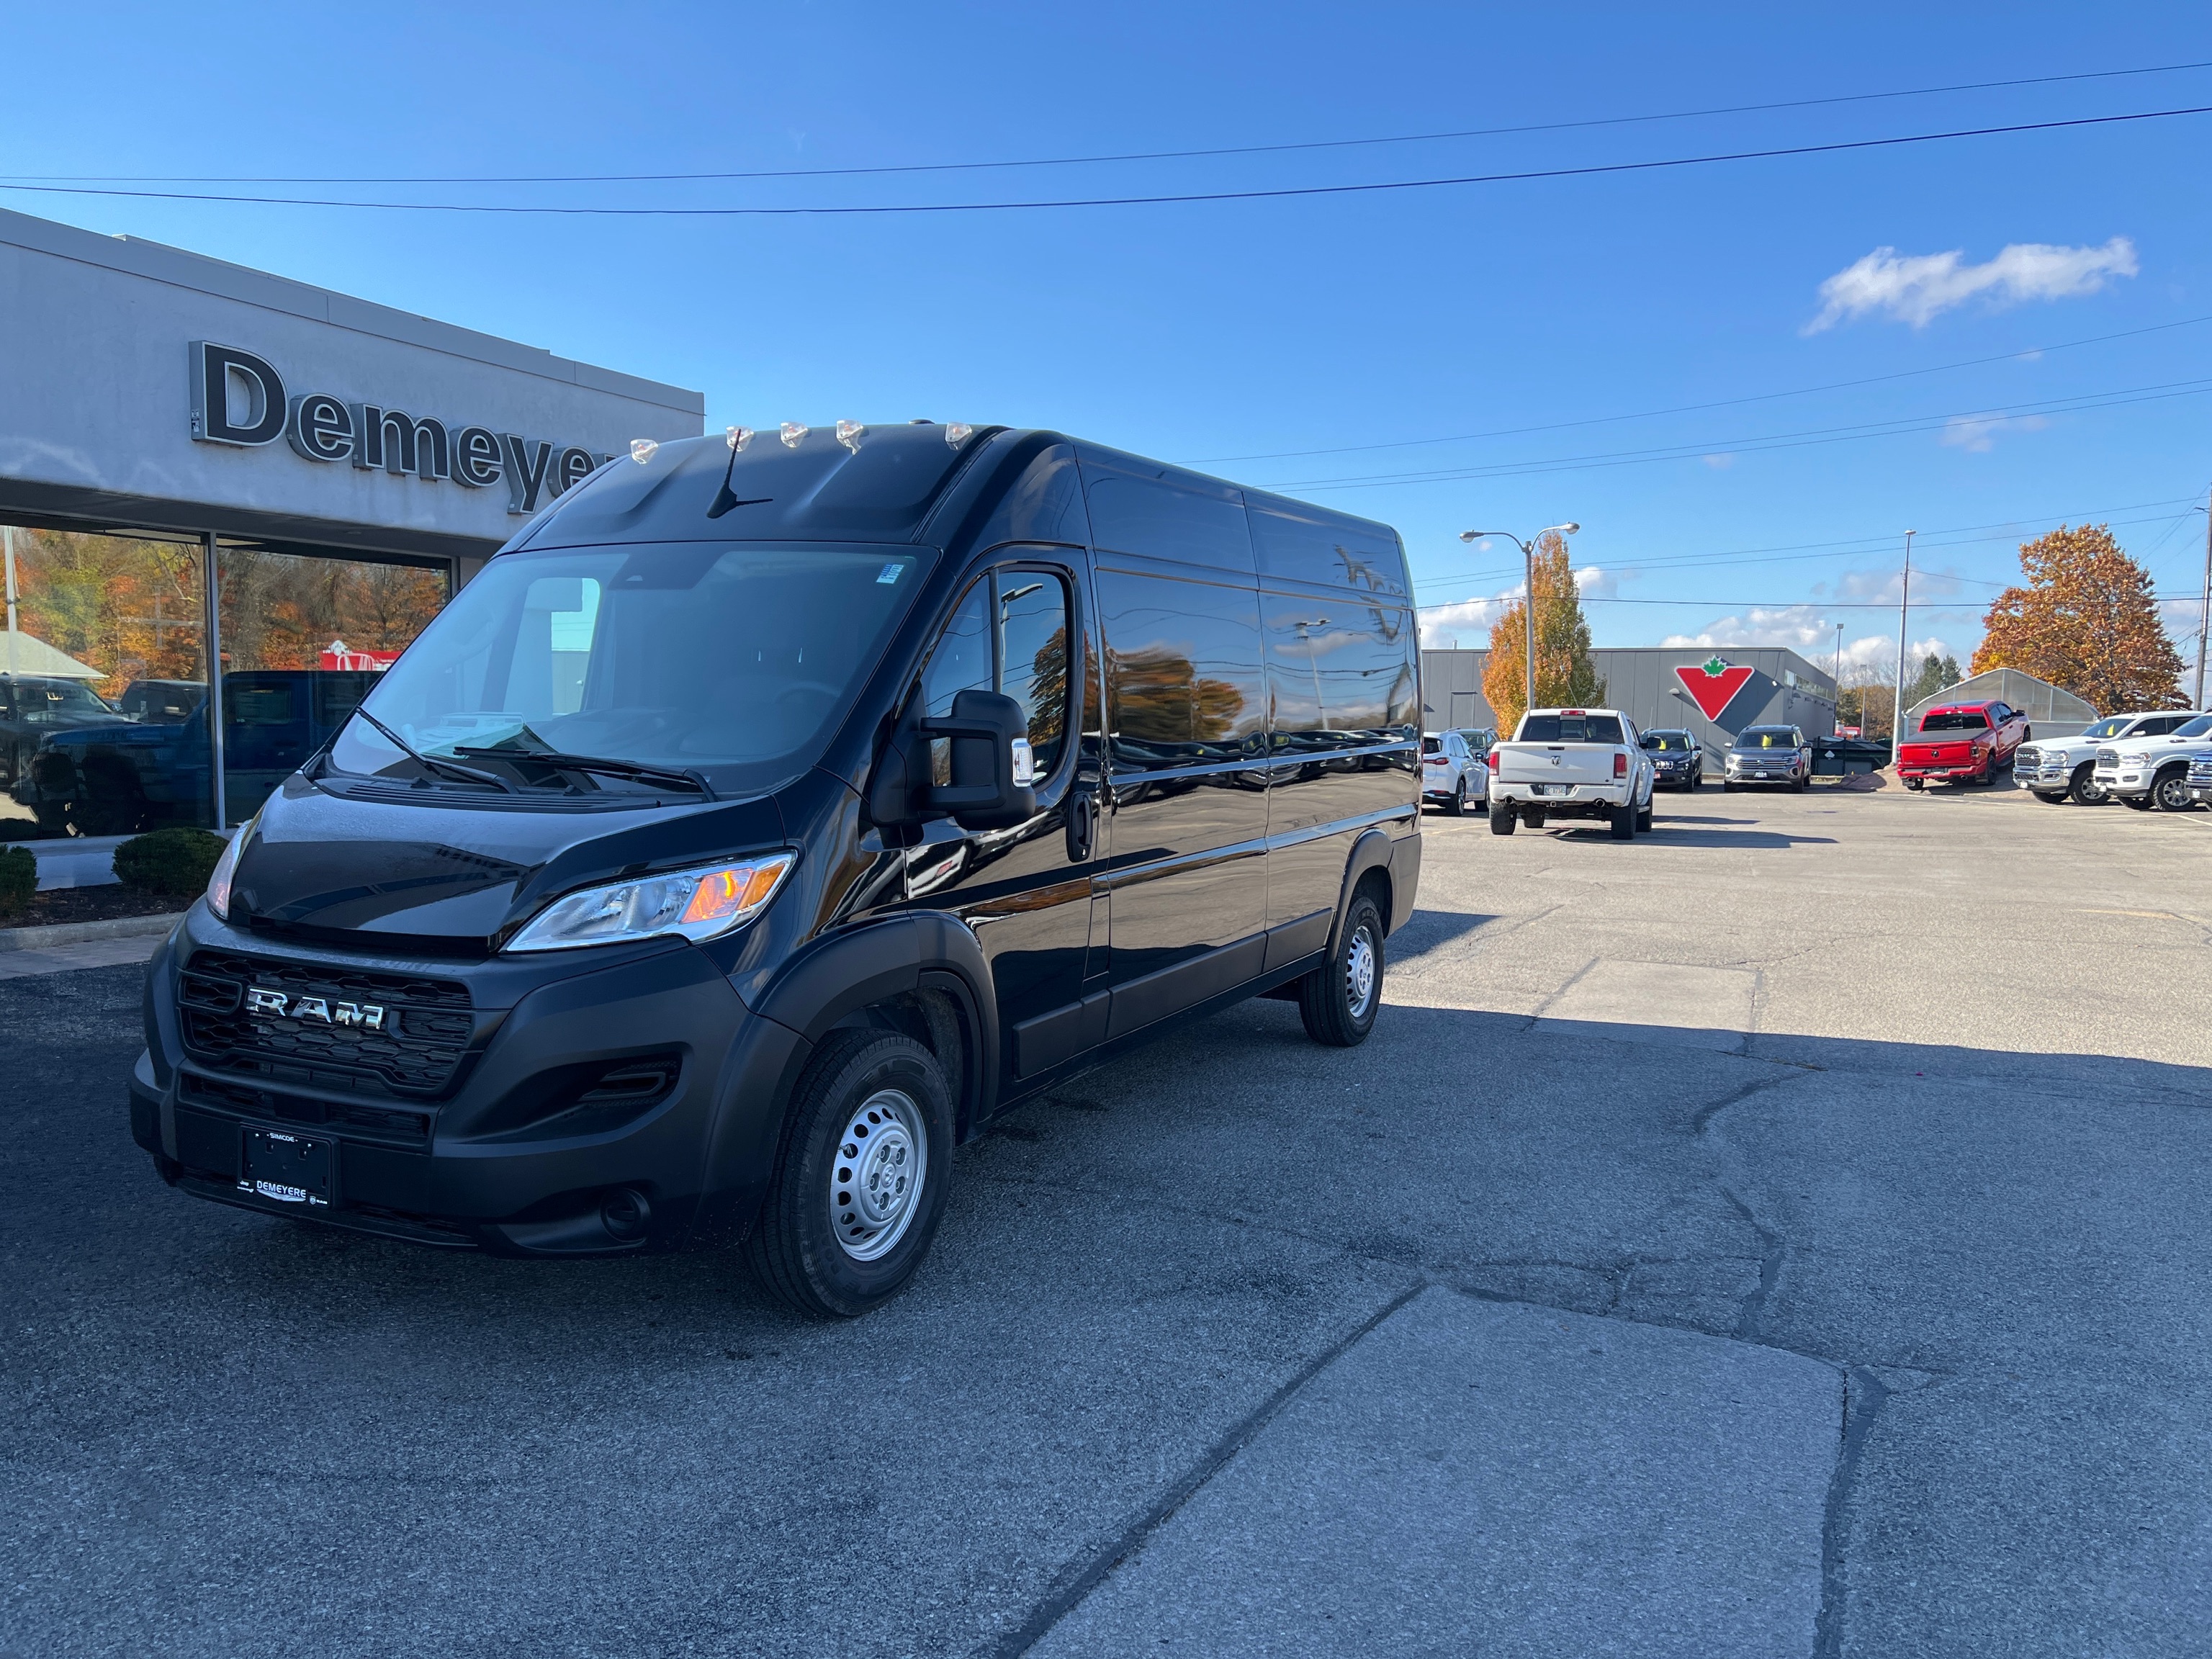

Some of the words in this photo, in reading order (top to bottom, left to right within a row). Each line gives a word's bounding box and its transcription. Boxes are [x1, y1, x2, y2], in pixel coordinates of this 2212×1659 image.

[189, 339, 619, 515] Demeye
[246, 988, 384, 1030] RAM
[269, 1132, 295, 1143] SIMCOE
[256, 1179, 307, 1198] DEMEYERE
